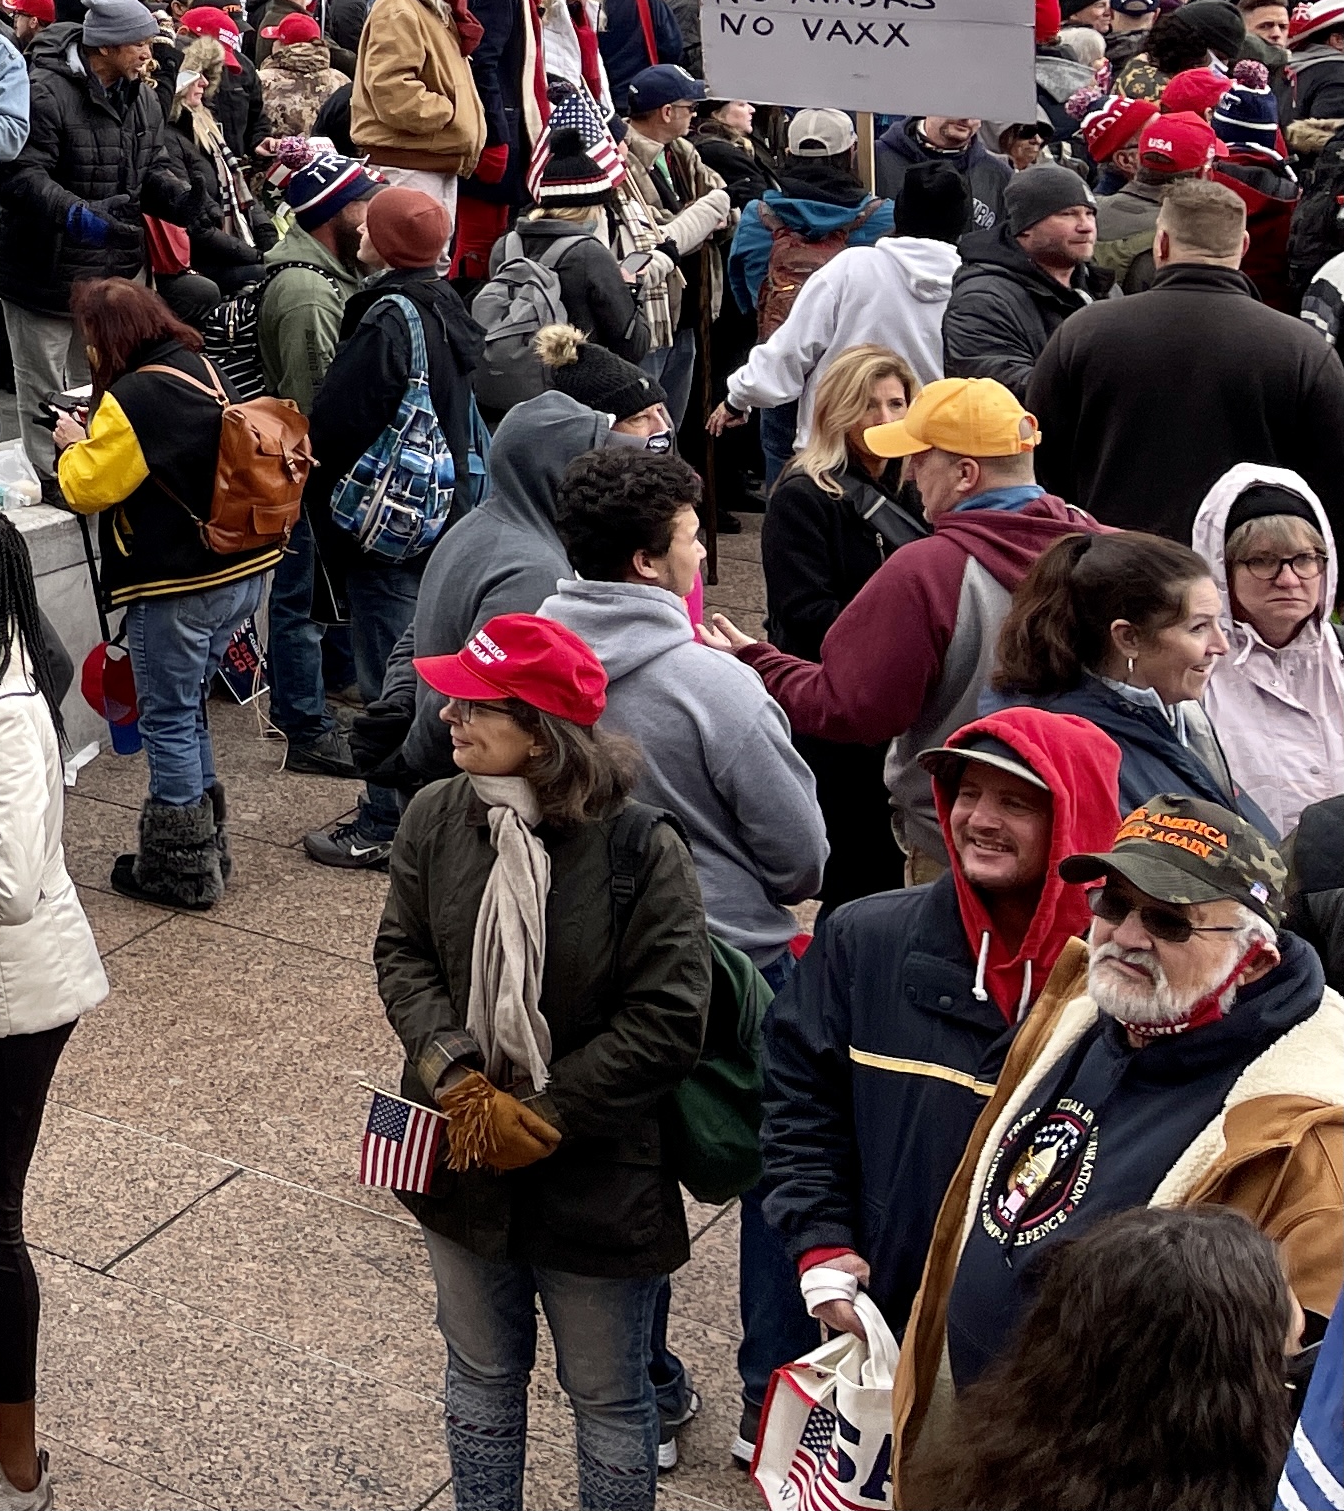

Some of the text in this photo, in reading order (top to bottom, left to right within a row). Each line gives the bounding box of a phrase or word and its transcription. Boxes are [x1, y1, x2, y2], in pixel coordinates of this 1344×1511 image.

[720, 13, 910, 48] NO VAXX
[1148, 138, 1172, 151] USA
[1147, 813, 1229, 848] AMERICA
[1153, 831, 1213, 858] AGAIN
